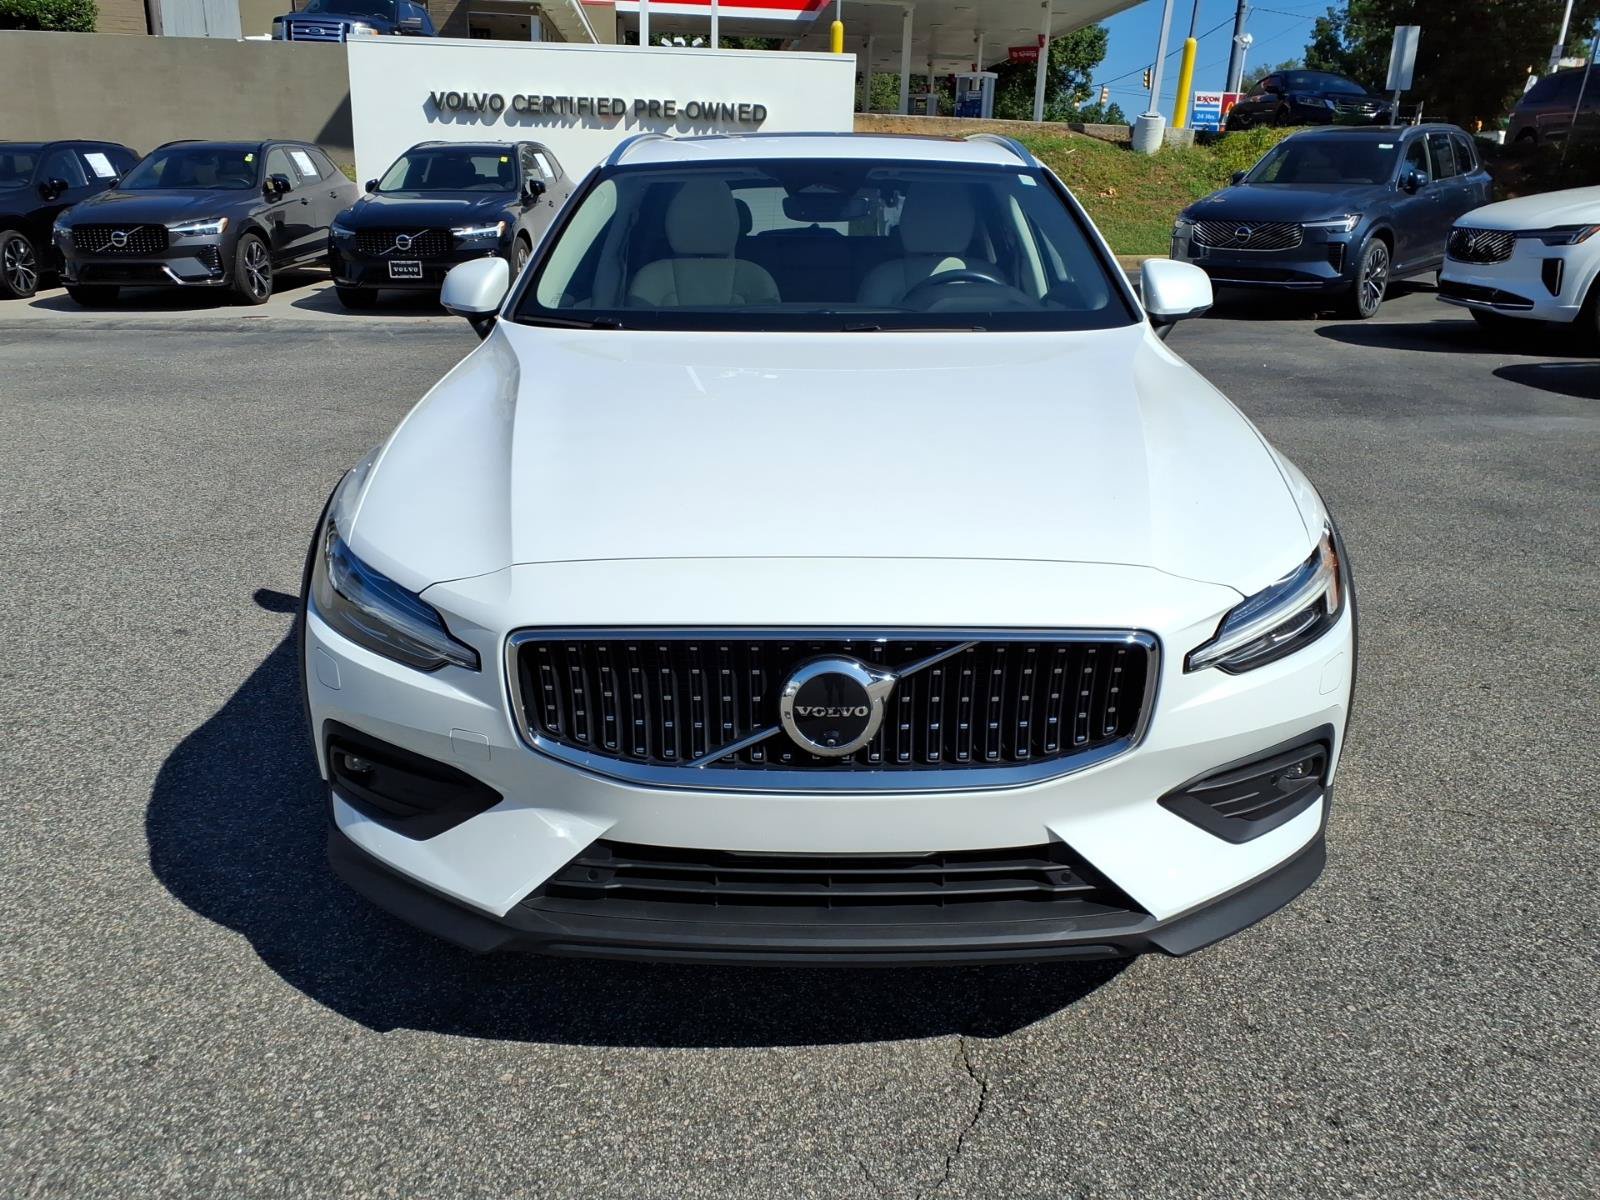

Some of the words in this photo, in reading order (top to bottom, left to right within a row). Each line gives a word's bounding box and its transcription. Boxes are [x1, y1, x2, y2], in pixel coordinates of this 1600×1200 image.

[1196, 95, 1220, 104] EXXON
[430, 91, 505, 113] VOLVO
[511, 94, 627, 116] CERTIFIED
[634, 98, 768, 122] PRE-OWNED
[795, 706, 868, 717] VOLVO
